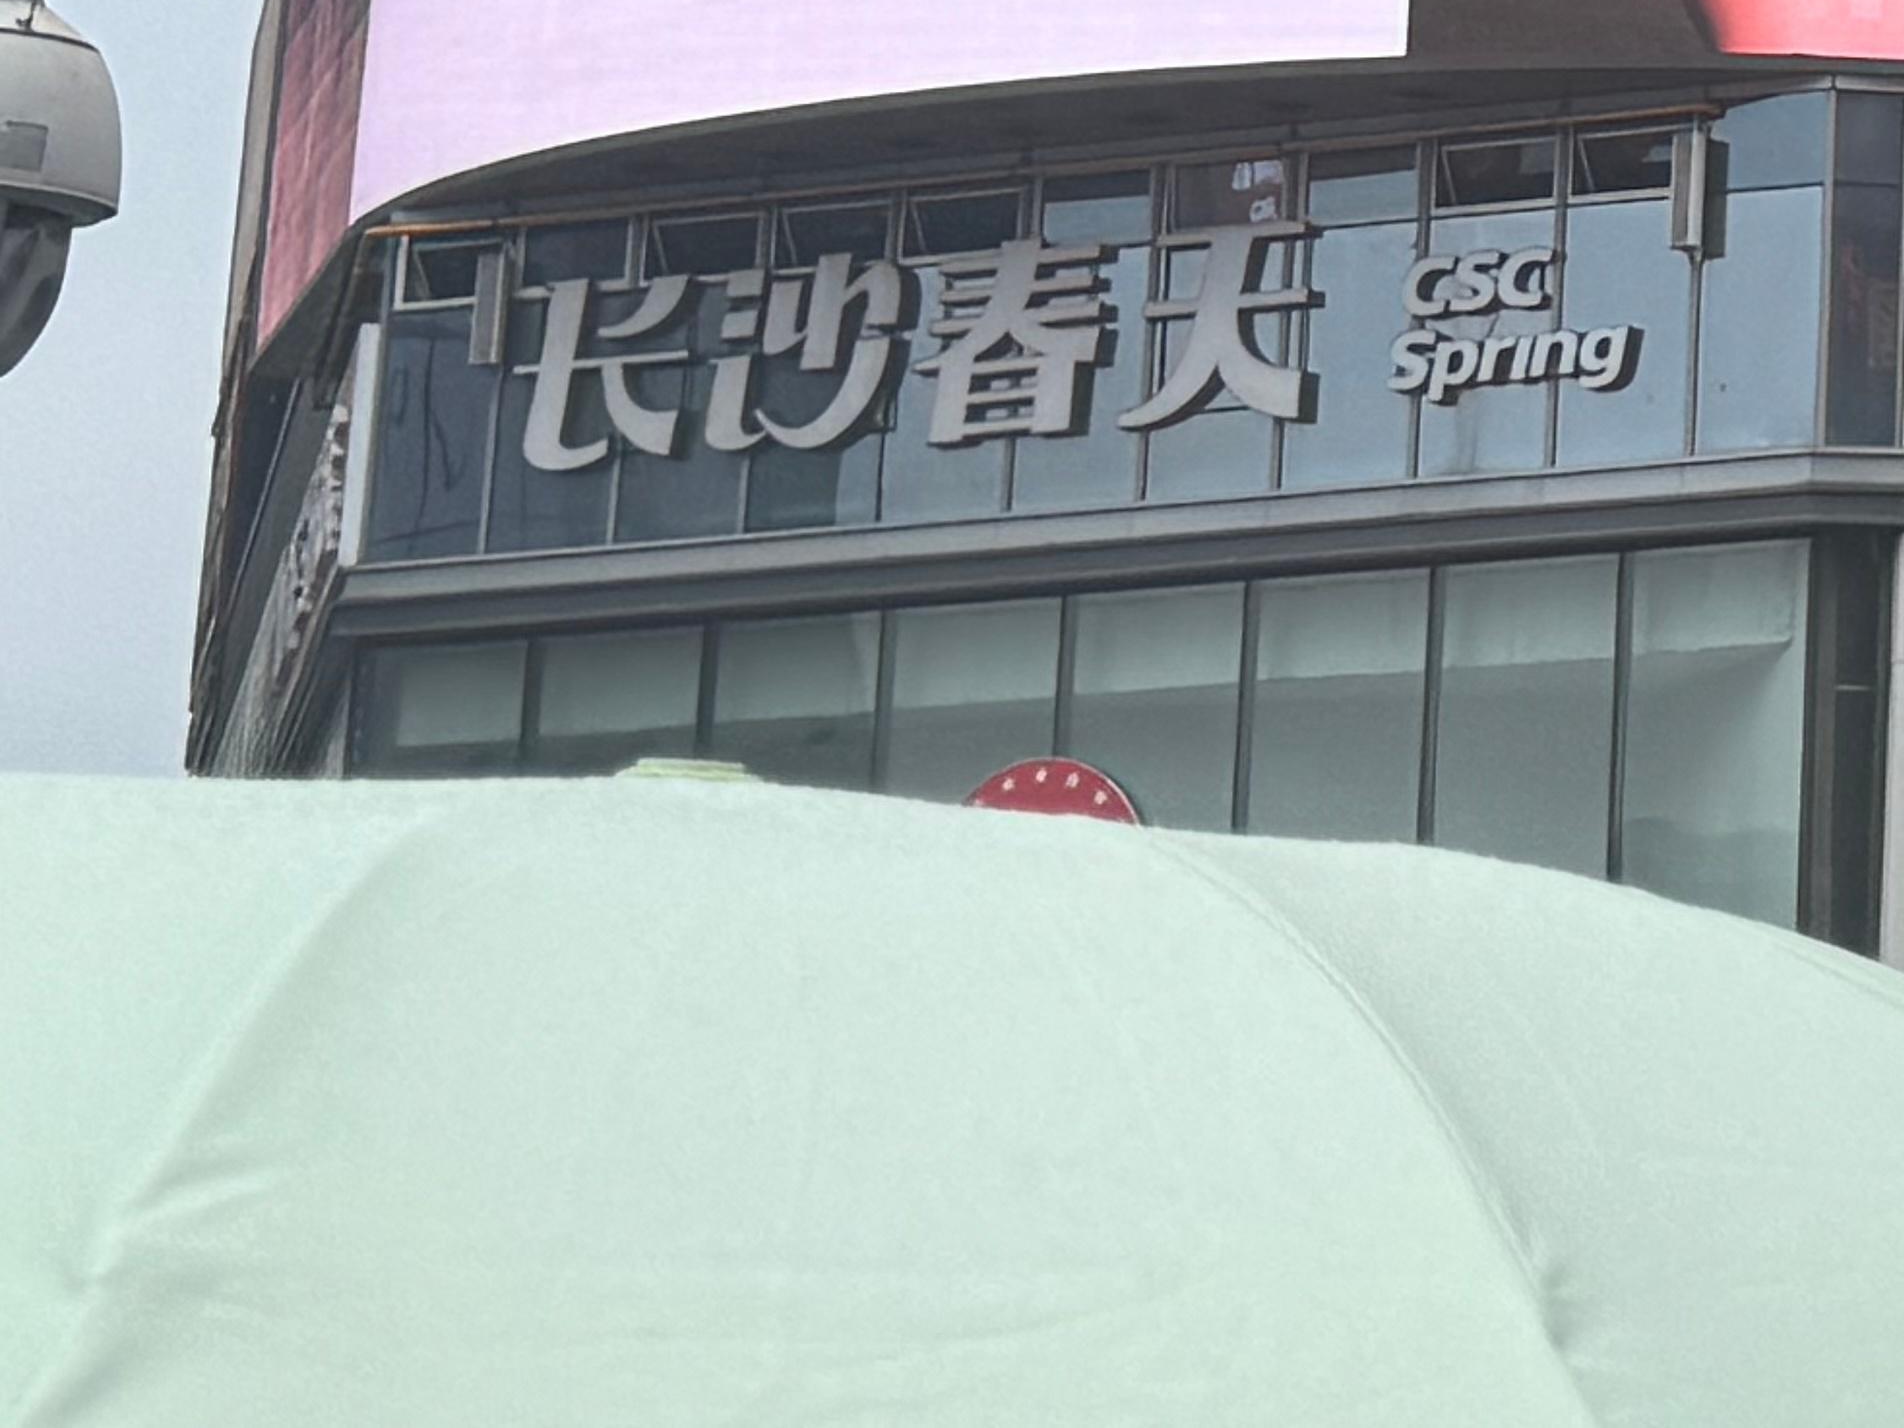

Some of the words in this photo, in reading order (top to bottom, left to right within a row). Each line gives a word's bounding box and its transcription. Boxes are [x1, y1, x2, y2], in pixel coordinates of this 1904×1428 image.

[514, 222, 1310, 472] 长沙春天
[1386, 322, 1632, 403] Spring
